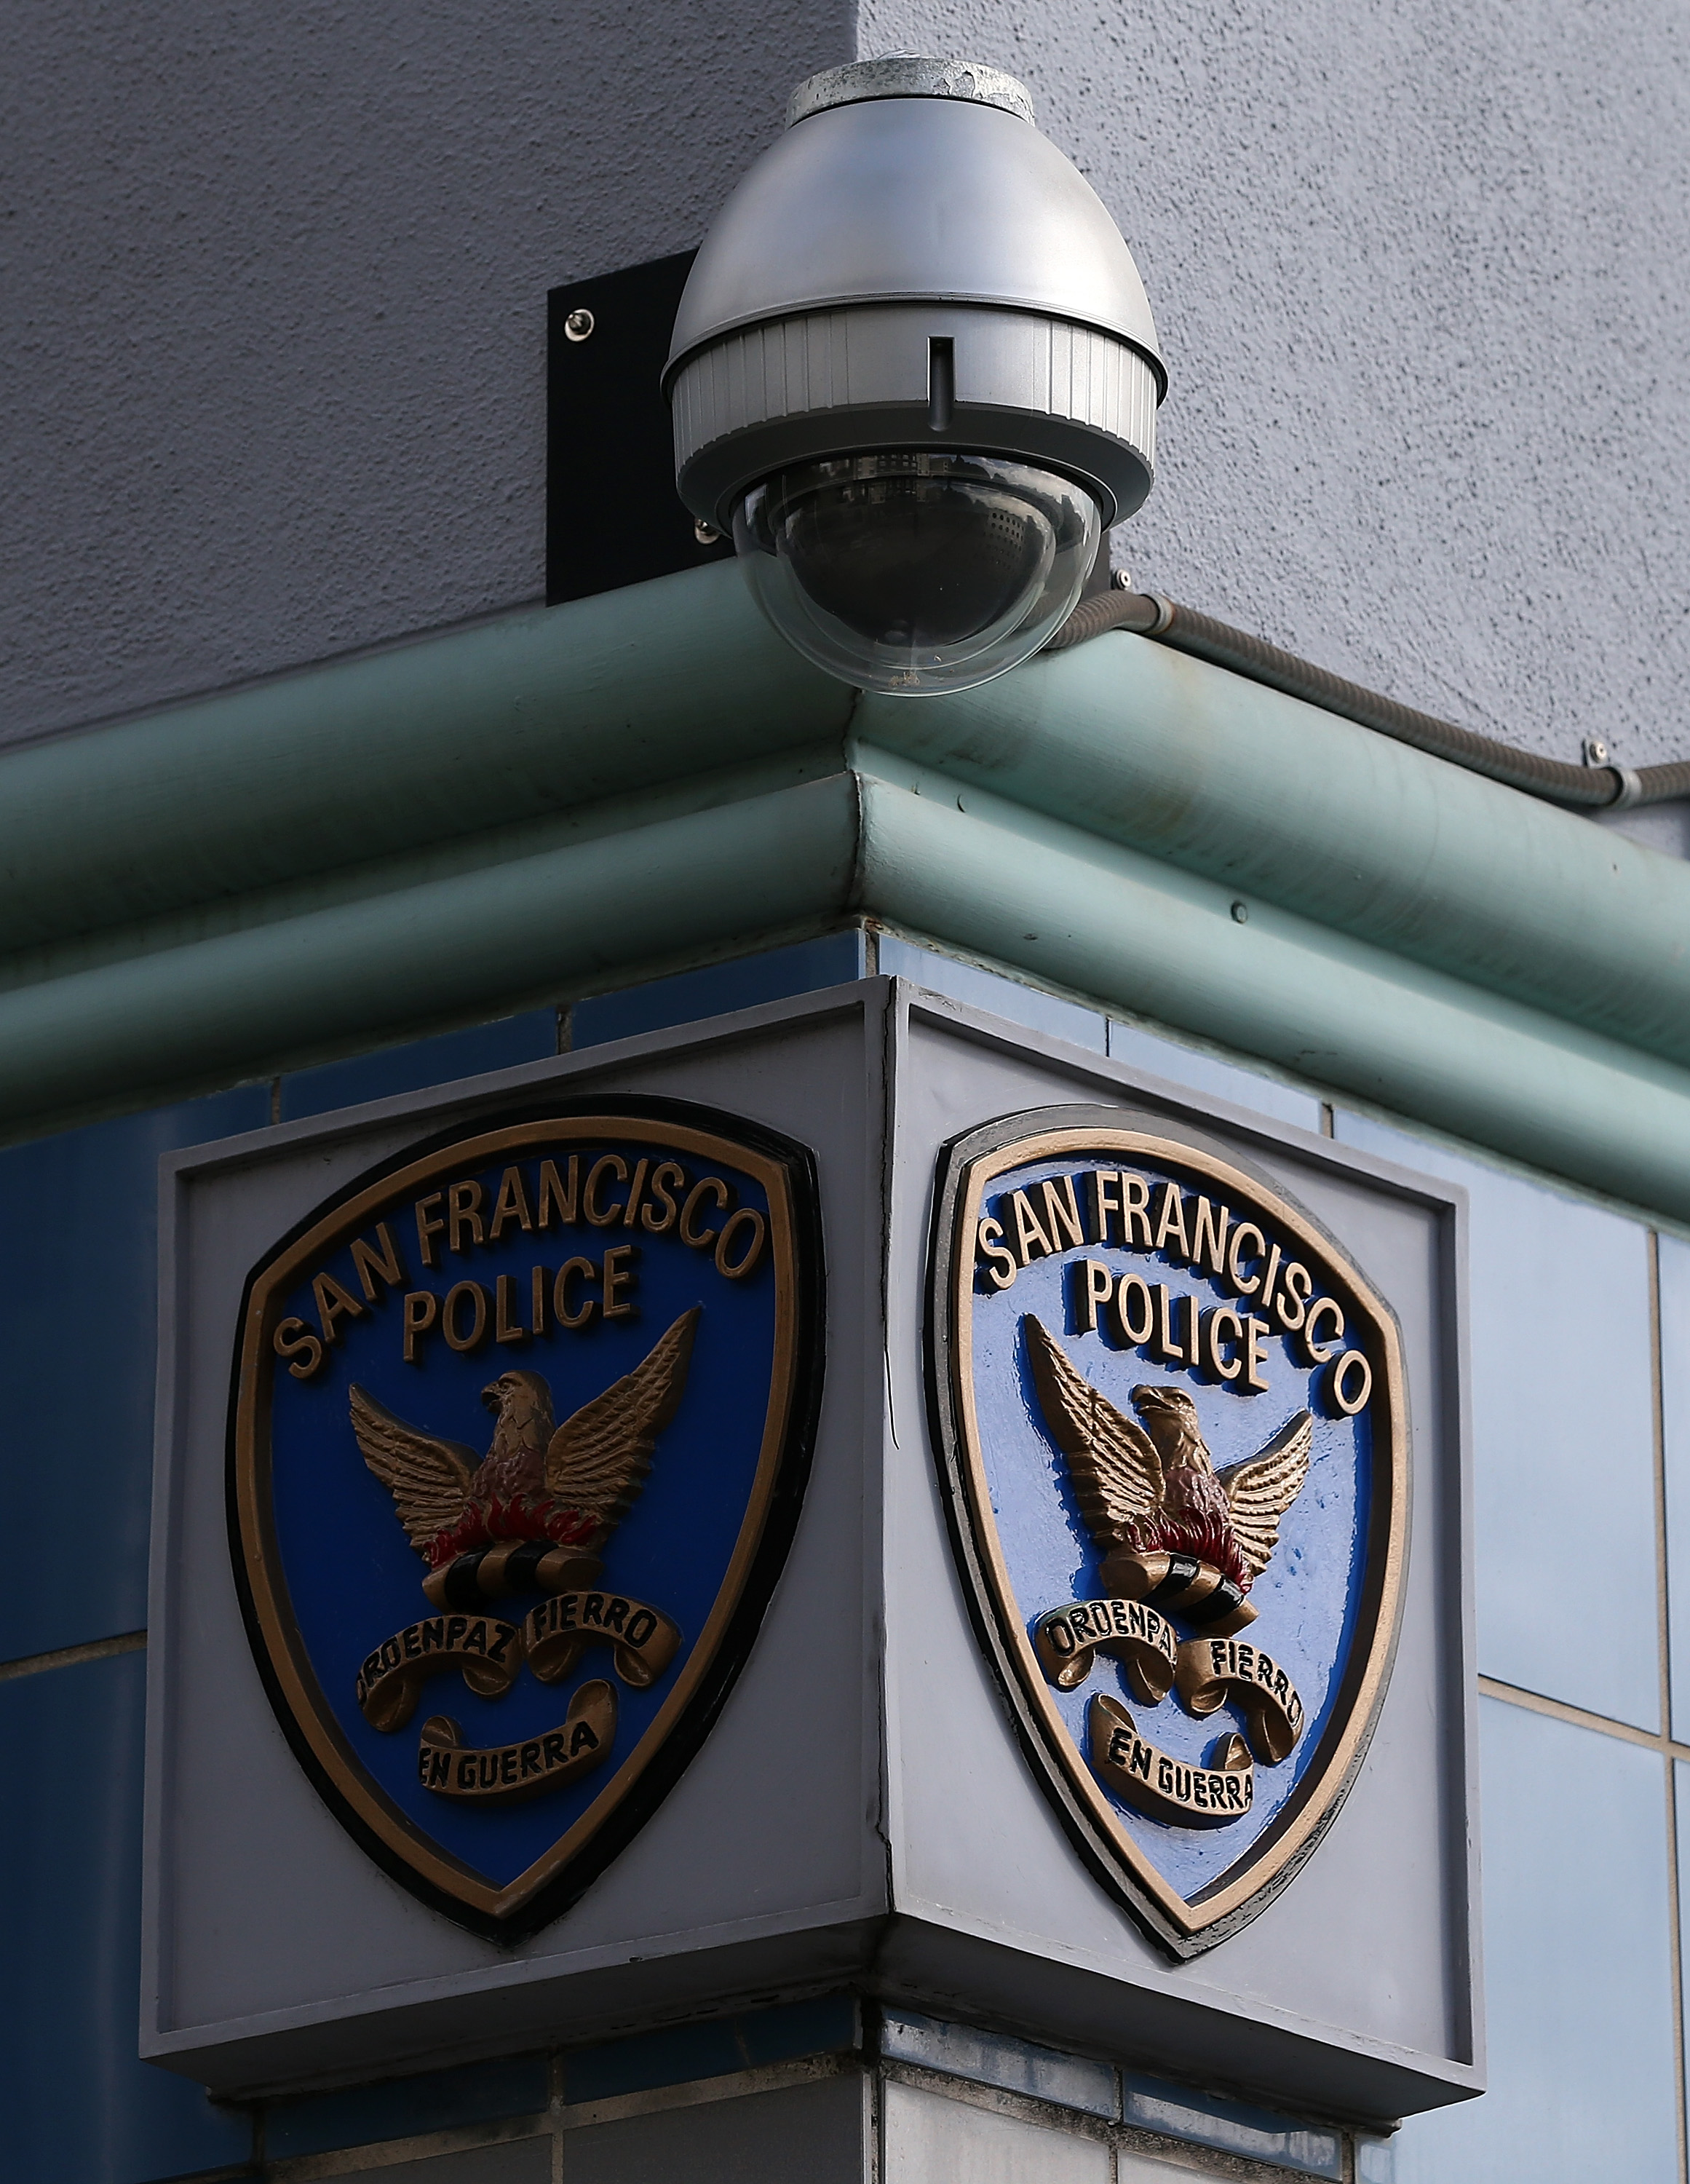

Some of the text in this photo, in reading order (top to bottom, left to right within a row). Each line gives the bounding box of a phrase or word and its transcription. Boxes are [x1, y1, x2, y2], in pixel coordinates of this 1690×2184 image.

[273, 1154, 766, 1380] SAN FRANCISCO
[402, 1245, 635, 1364] POLICE
[978, 1170, 1372, 1415] SAN FRANCISCO
[1080, 1259, 1269, 1393] POLICE
[531, 1594, 658, 1649] FIERRO
[1210, 1640, 1302, 1727] FIERRO
[418, 1720, 599, 1792] EN GUERRA
[1108, 1726, 1253, 1810] EN GUERRA
